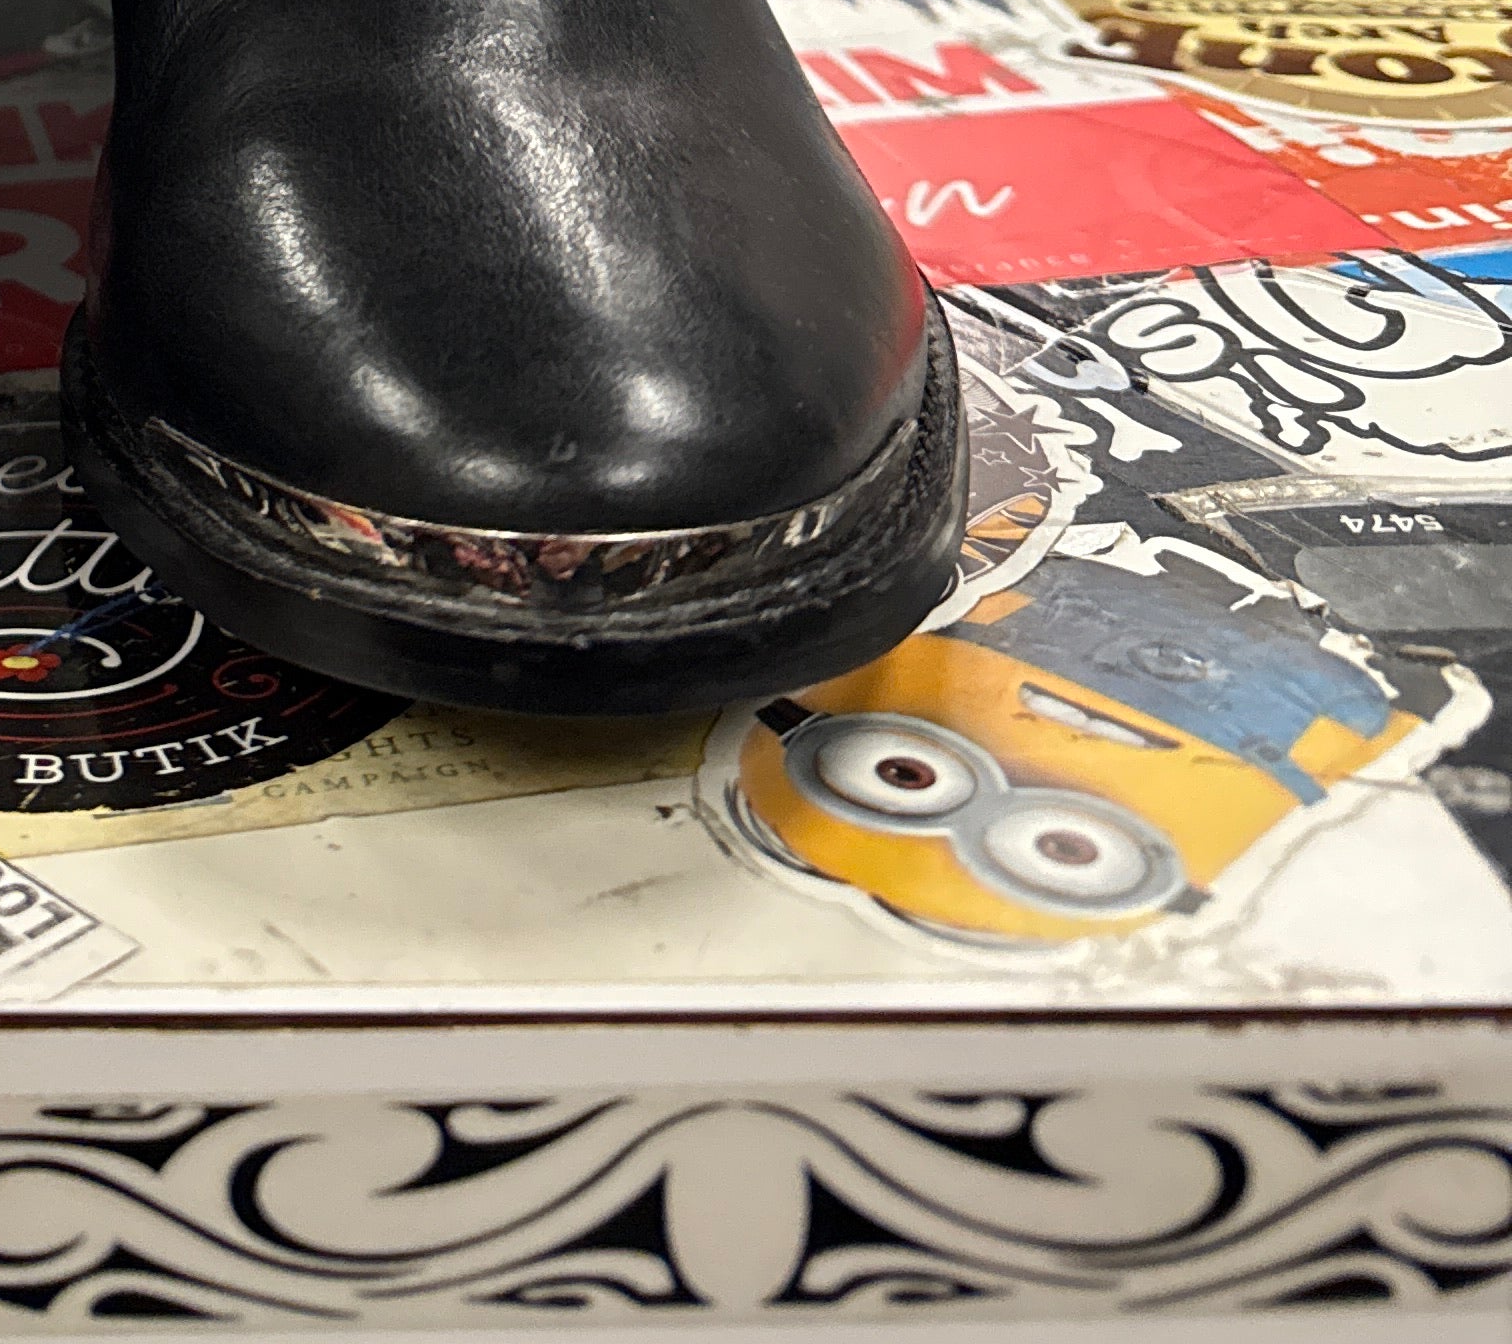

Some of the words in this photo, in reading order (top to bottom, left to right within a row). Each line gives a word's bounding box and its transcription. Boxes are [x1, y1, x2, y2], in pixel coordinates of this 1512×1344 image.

[1238, 12, 1448, 44] Arch
[1339, 511, 1445, 534] 5474
[16, 714, 290, 786] BUTIK
